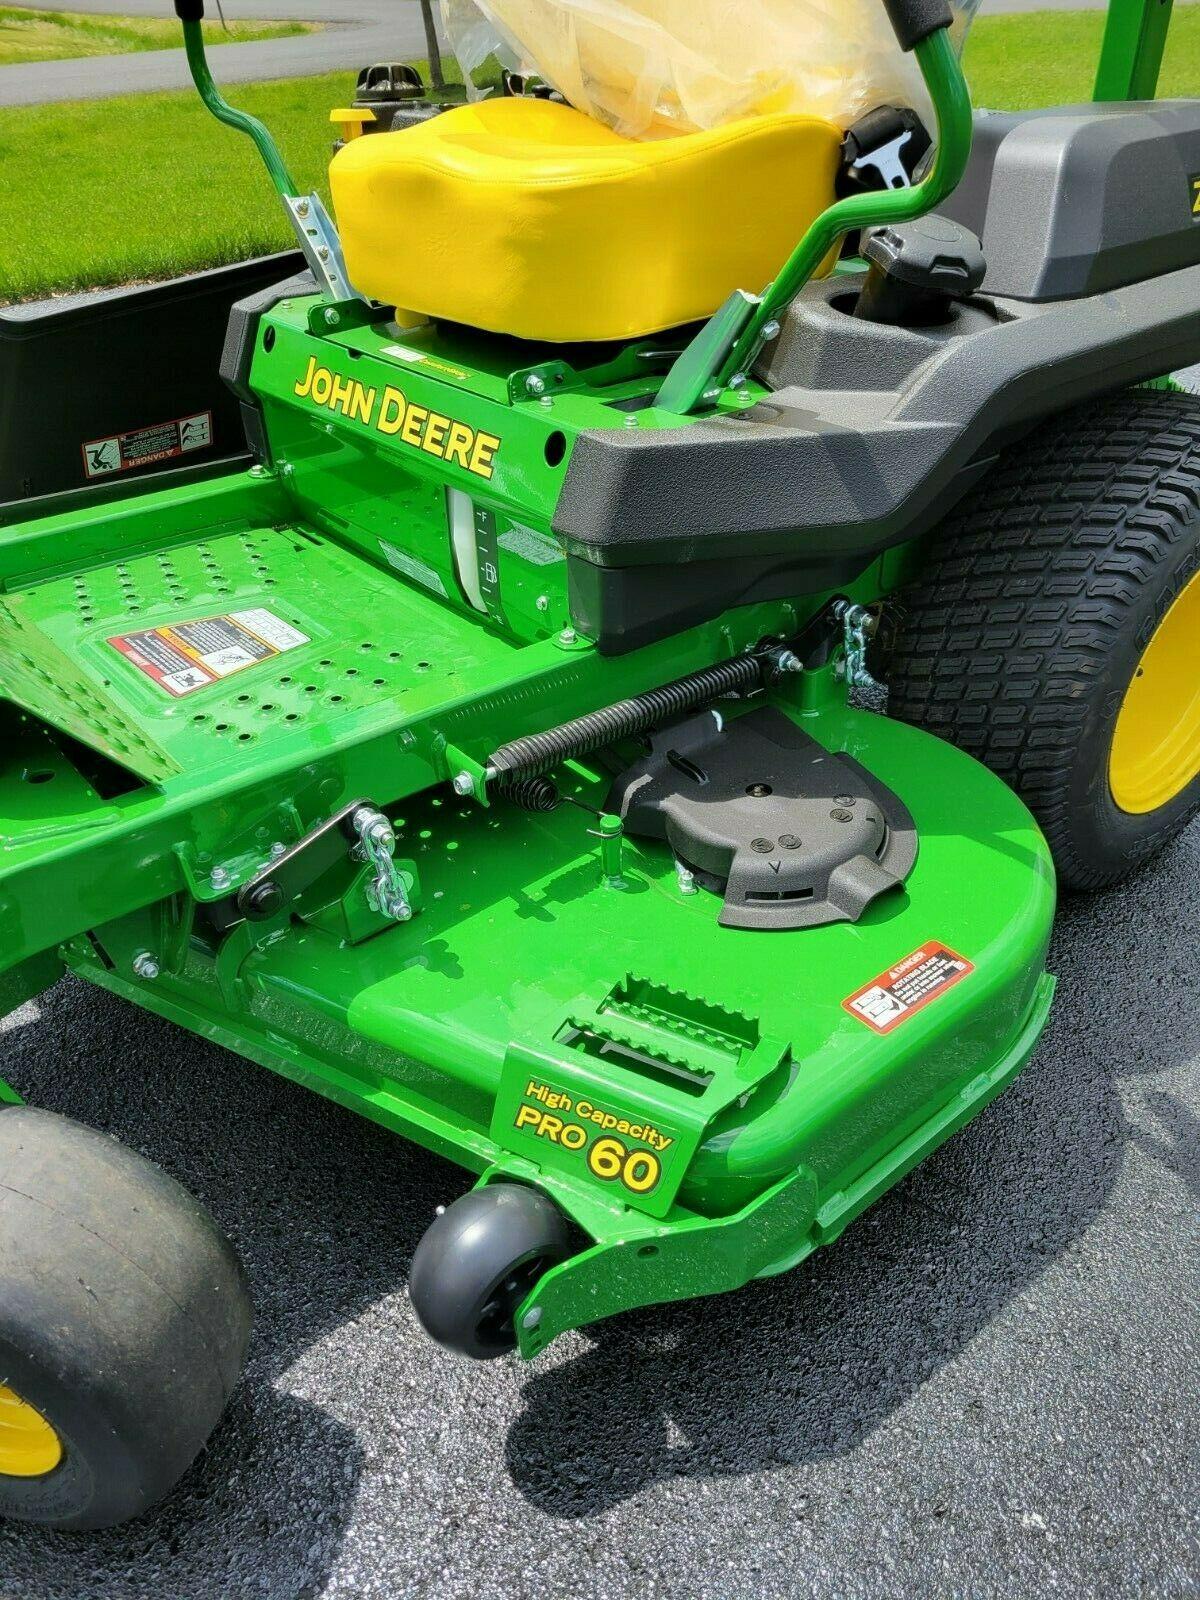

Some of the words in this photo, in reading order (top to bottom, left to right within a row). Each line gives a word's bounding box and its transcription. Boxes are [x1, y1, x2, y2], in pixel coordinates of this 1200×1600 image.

[295, 355, 376, 425] JOHN
[376, 384, 502, 480] DEERE
[514, 1103, 588, 1150] PRO
[586, 1134, 662, 1195] 60
[525, 1081, 573, 1112] High
[575, 1101, 675, 1151] Capacity
